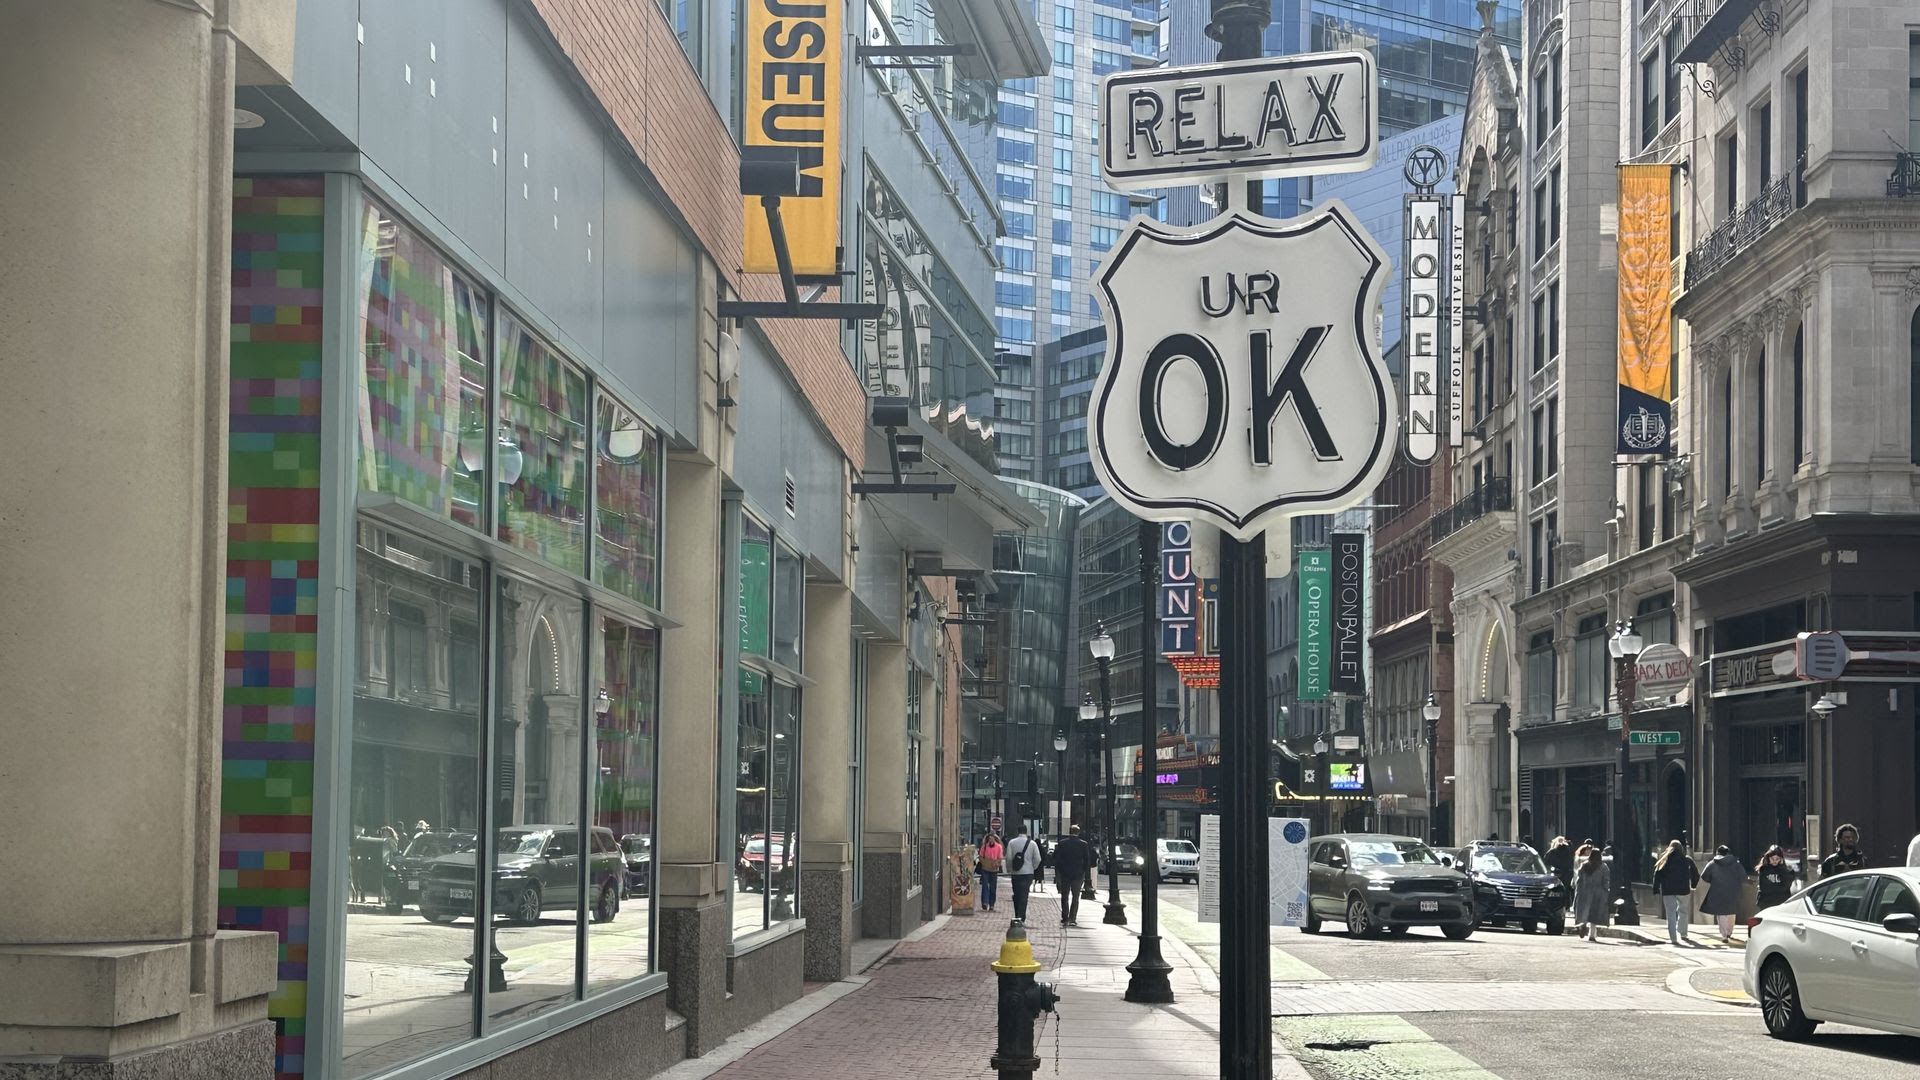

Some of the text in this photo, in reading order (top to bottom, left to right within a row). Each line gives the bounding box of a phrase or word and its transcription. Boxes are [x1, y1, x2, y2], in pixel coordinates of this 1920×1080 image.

[1127, 73, 1345, 159] RELAX
[1199, 271, 1281, 318] UR
[1411, 215, 1438, 433] MODERN
[1451, 225, 1463, 421] SUFFOLK UNIVERSITY
[1138, 323, 1344, 472] OK
[1307, 586, 1322, 693] OPERA HOUSE
[1666, 658, 1695, 679] DECK
[1638, 733, 1662, 743] WEST
